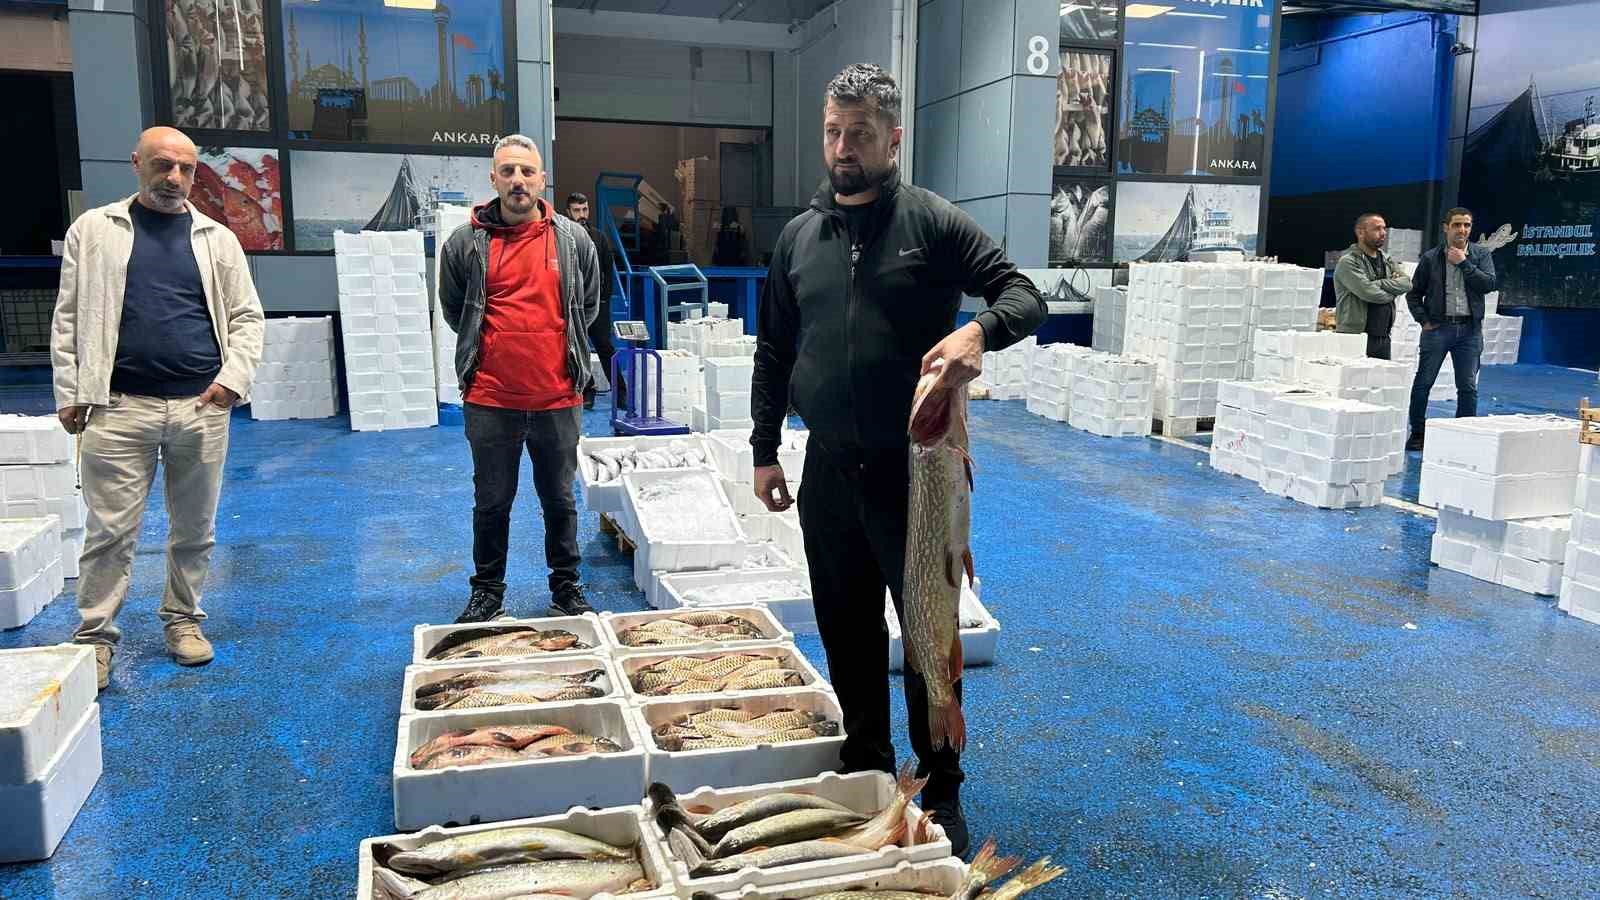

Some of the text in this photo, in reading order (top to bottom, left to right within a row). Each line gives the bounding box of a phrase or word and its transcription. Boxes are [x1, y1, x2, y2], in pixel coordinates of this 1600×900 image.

[1027, 35, 1049, 76] 8
[432, 131, 502, 144] ANKARA
[1209, 159, 1257, 170] ANKARA
[1522, 224, 1593, 239] İSTANBUL
[1517, 243, 1596, 259] BALIKÇILIK
